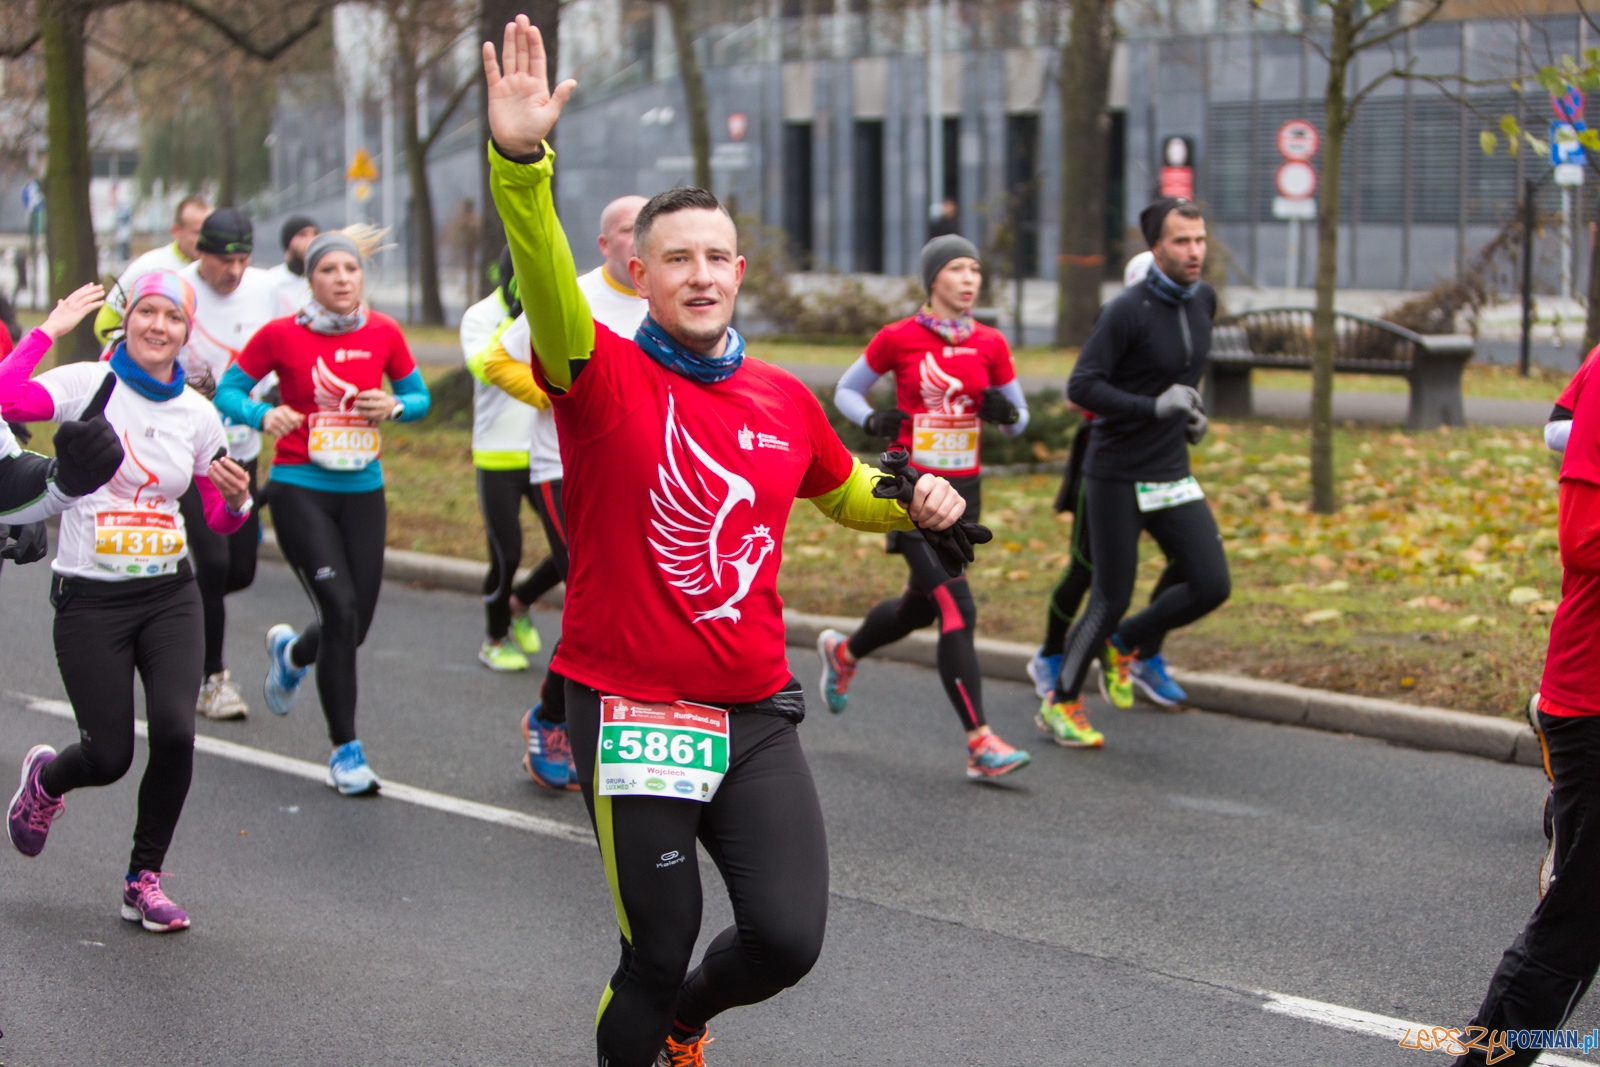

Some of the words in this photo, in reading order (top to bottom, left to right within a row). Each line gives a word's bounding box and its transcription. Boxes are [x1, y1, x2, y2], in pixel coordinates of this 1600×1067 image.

[319, 431, 374, 450] 3400
[931, 432, 969, 450] 268
[110, 531, 176, 554] 1319
[673, 712, 721, 728] RunPoland.org
[617, 730, 713, 768] 5861
[646, 767, 686, 777] Wojciech
